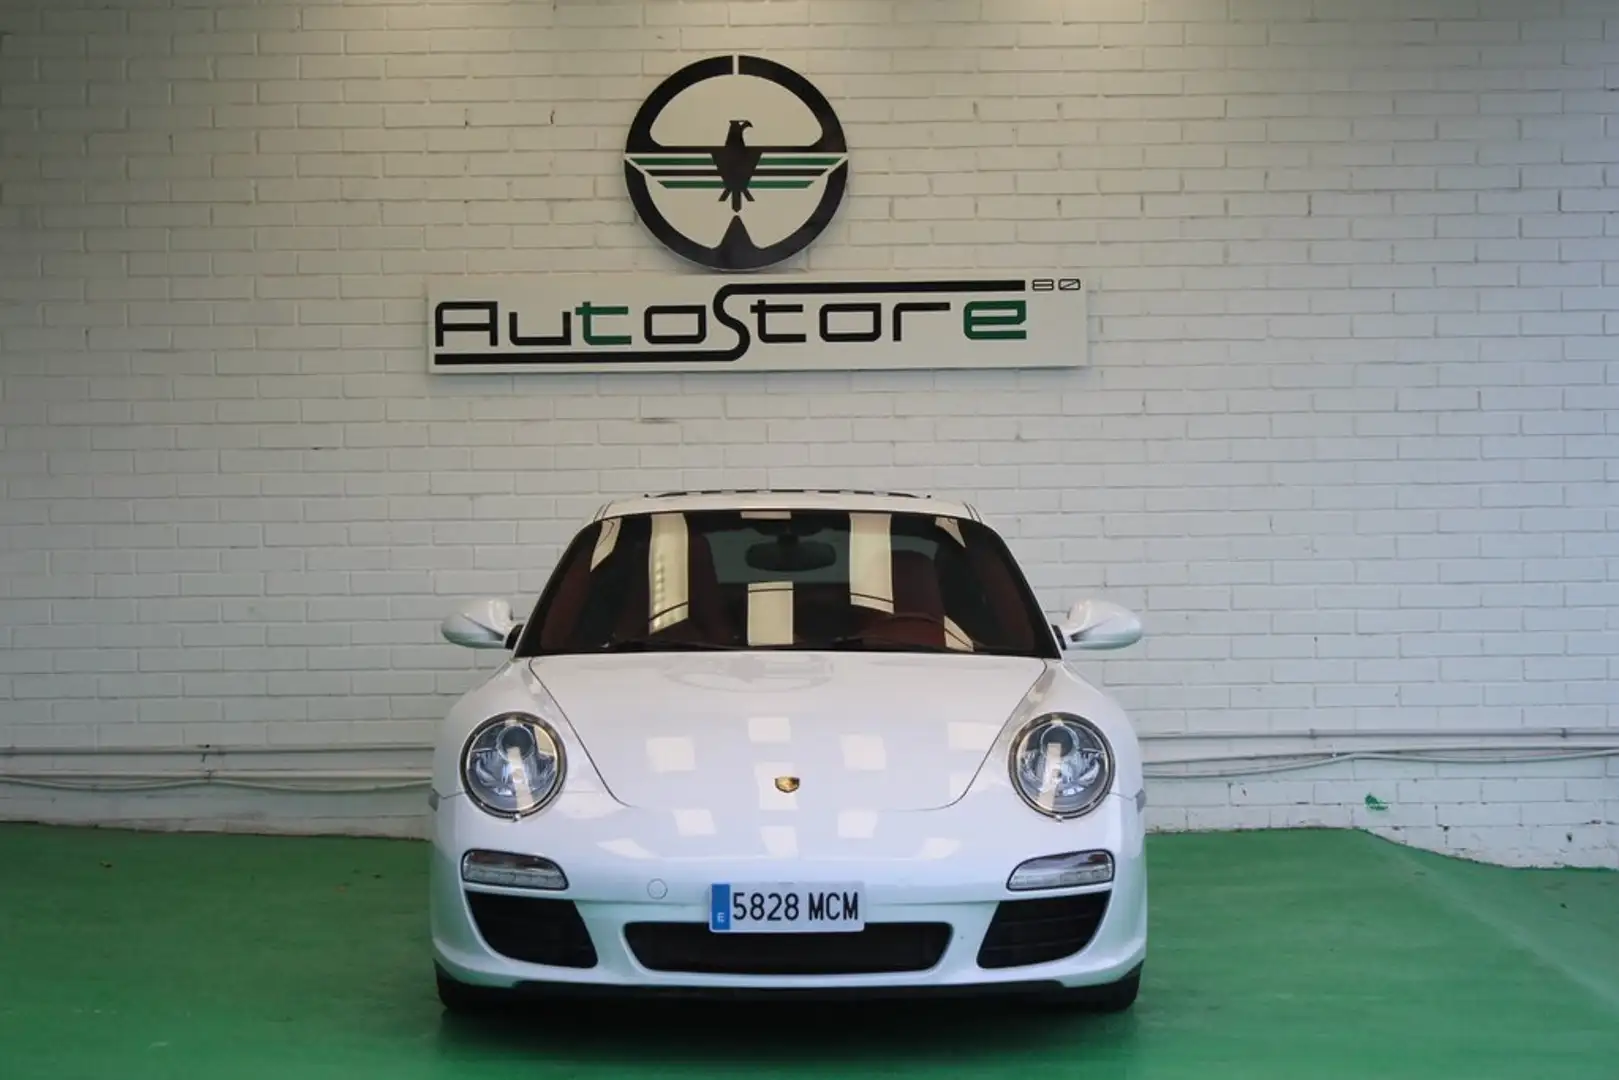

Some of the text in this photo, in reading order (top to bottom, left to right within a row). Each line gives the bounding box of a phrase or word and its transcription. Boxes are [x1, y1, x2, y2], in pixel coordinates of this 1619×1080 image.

[435, 281, 1027, 364] AutoStore
[716, 912, 725, 923] E
[732, 891, 859, 921] 5828 MCM
